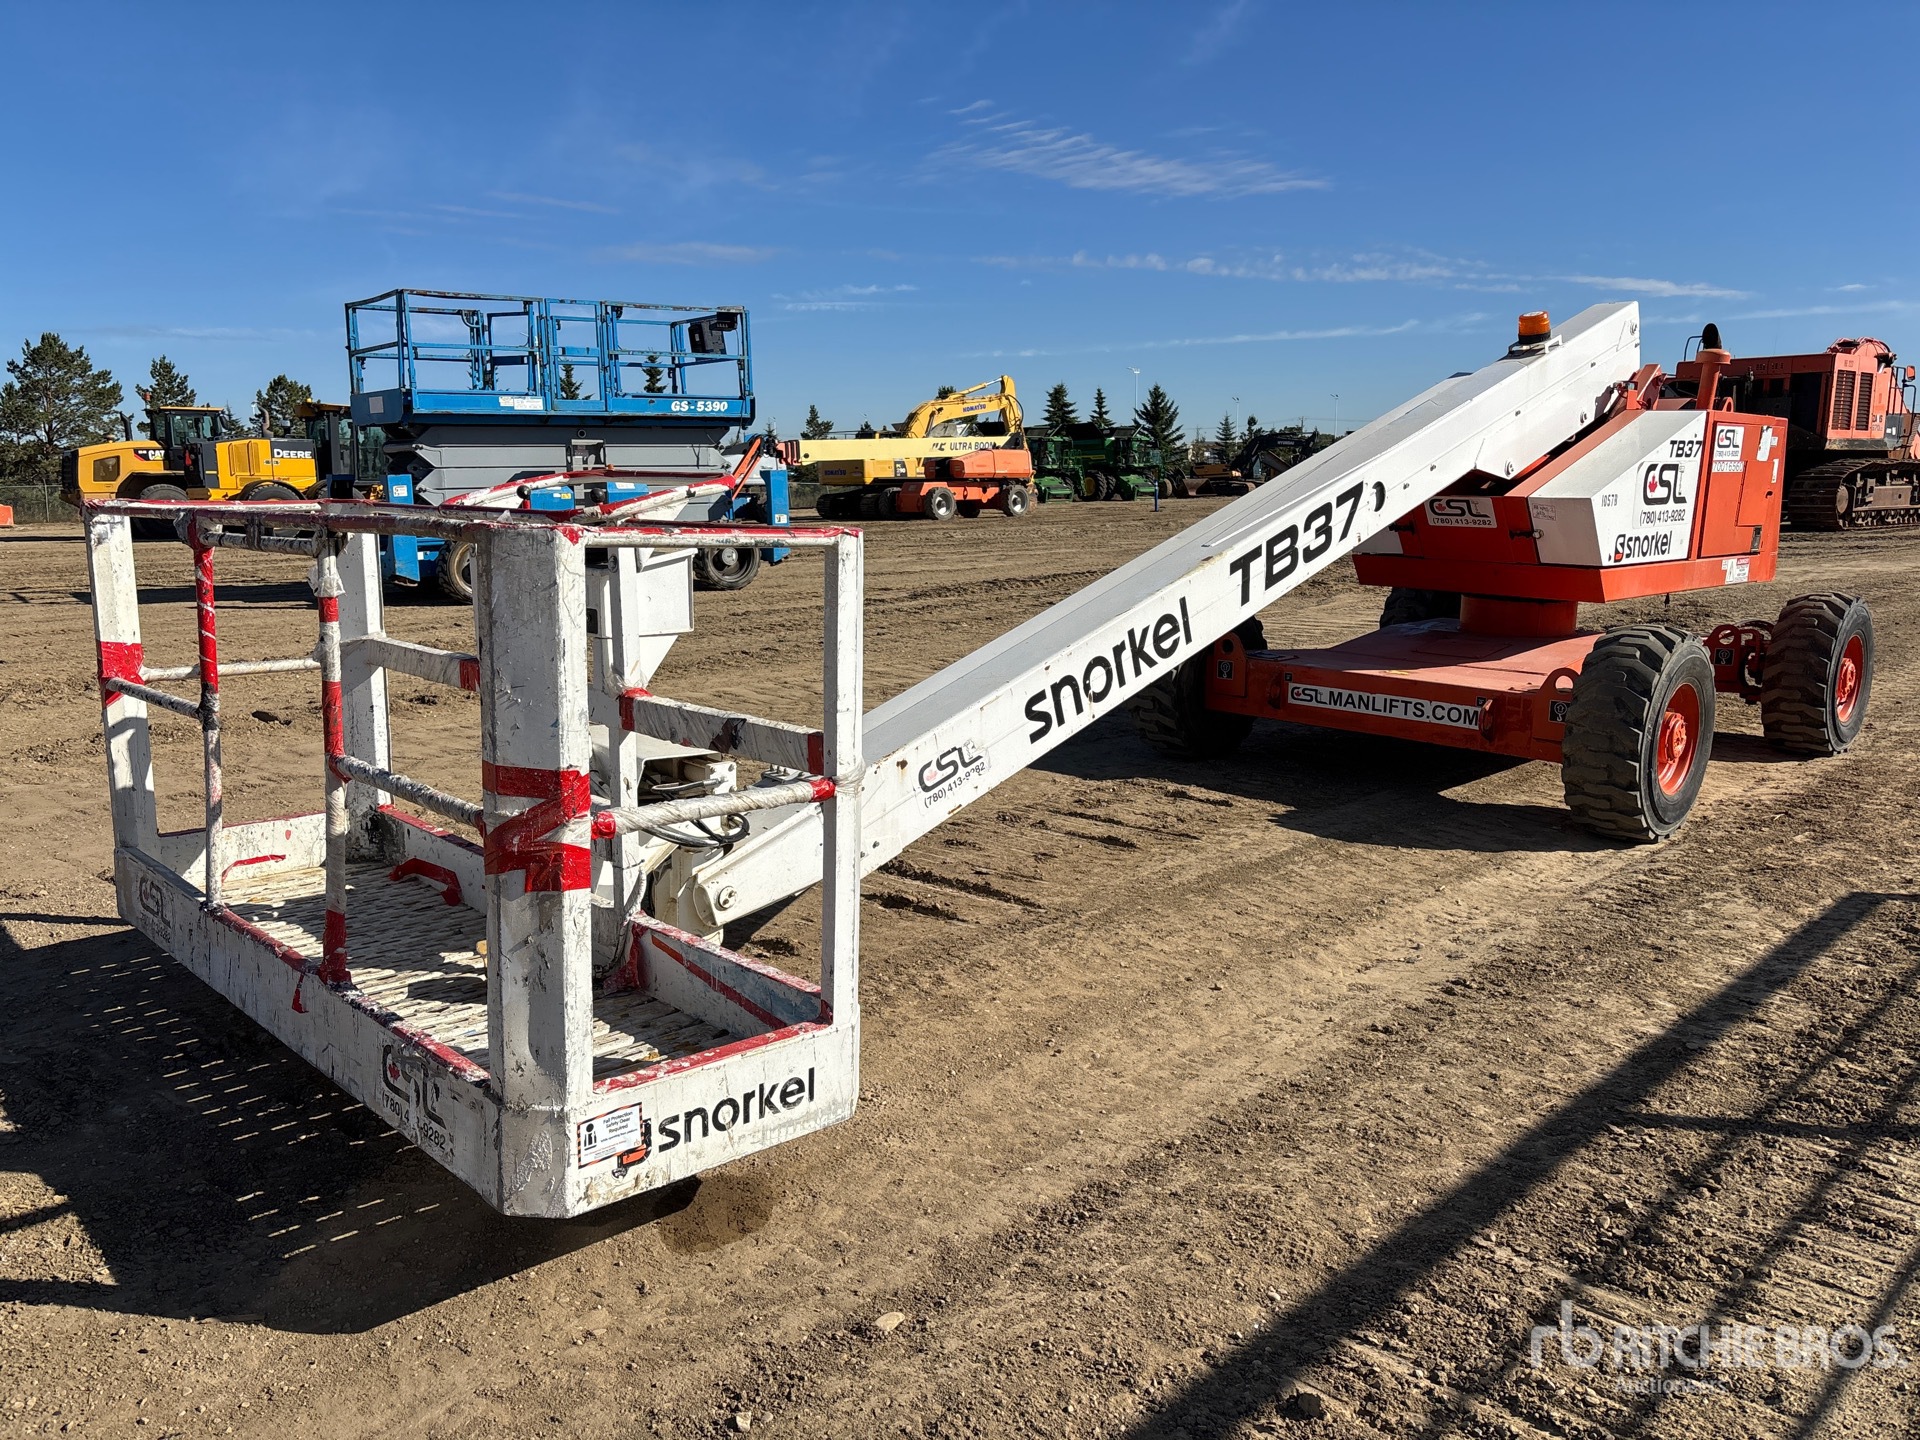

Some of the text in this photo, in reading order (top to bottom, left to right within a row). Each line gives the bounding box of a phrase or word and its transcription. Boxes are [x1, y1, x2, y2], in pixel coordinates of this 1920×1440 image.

[671, 400, 728, 412] GS-5390
[950, 442, 972, 450] ULTRA
[1717, 429, 1740, 448] CSL
[148, 450, 165, 460] CAT
[274, 448, 312, 459] DEERE
[1669, 440, 1703, 458] TB37
[1643, 463, 1688, 506] CSL
[1429, 498, 1491, 518] CSL
[1639, 509, 1686, 527] (780) 413-9282
[1432, 518, 1492, 526] (780) 413-9282
[1229, 480, 1364, 607] TB37
[1625, 530, 1673, 559] snorkel
[1024, 596, 1193, 745] snorkel
[1291, 686, 1479, 726] CSL MANLIFTS.COM
[918, 746, 983, 793] CSL
[924, 787, 947, 808] (780)
[657, 1066, 815, 1153] snorkel
[382, 1091, 446, 1151] (780) 4-9282
